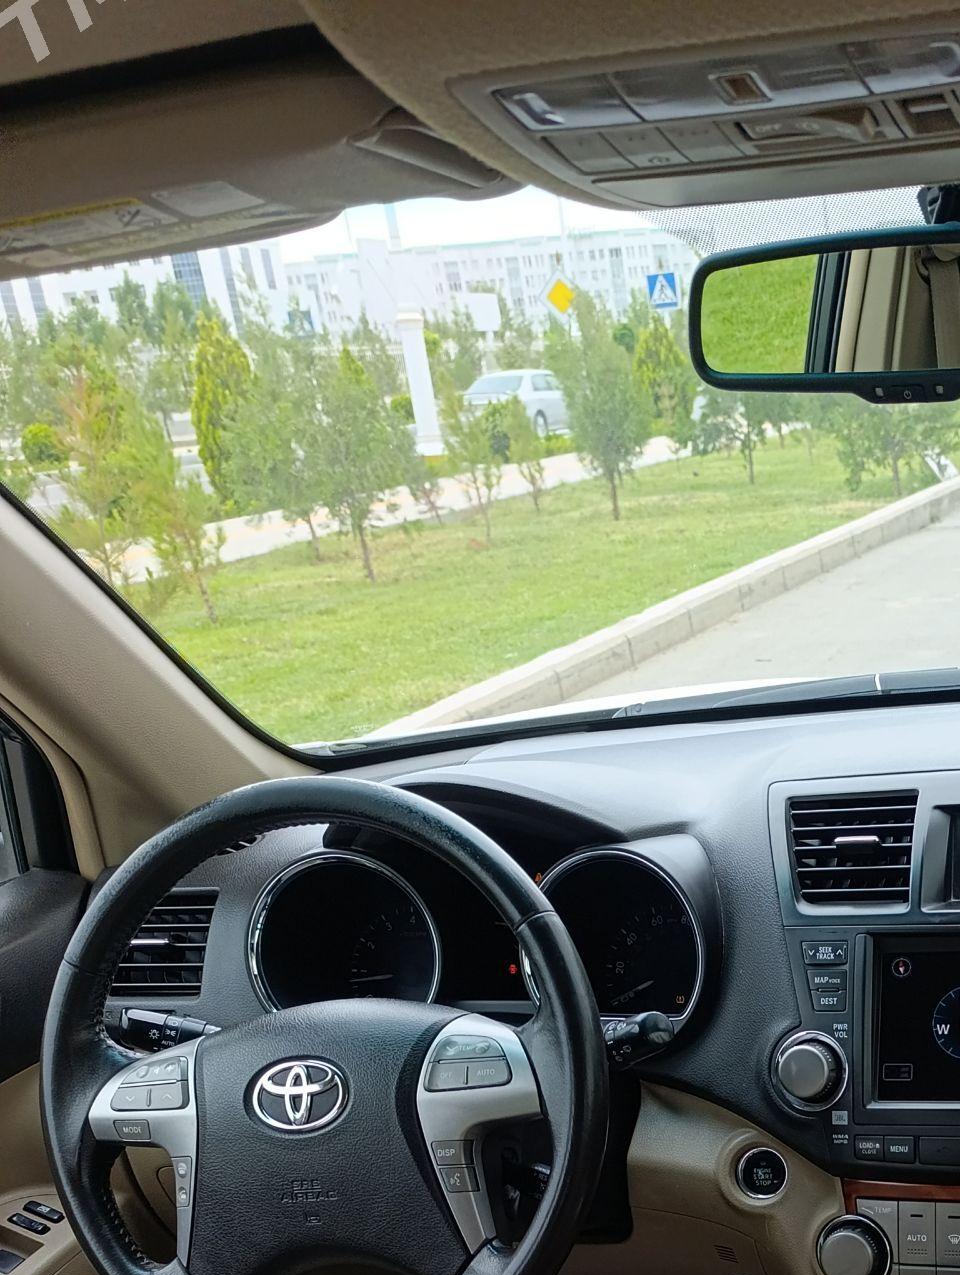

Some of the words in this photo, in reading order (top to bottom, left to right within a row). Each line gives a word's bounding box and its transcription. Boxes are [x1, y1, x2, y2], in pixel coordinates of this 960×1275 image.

[651, 915, 663, 926] 60
[385, 922, 392, 931] 3
[626, 932, 638, 945] 40
[616, 961, 624, 974] 20
[937, 1024, 950, 1035] W
[476, 1068, 495, 1077] AUTO
[123, 1126, 142, 1134] MODE
[437, 1149, 456, 1157] DISP
[907, 1234, 927, 1242] AUTO
